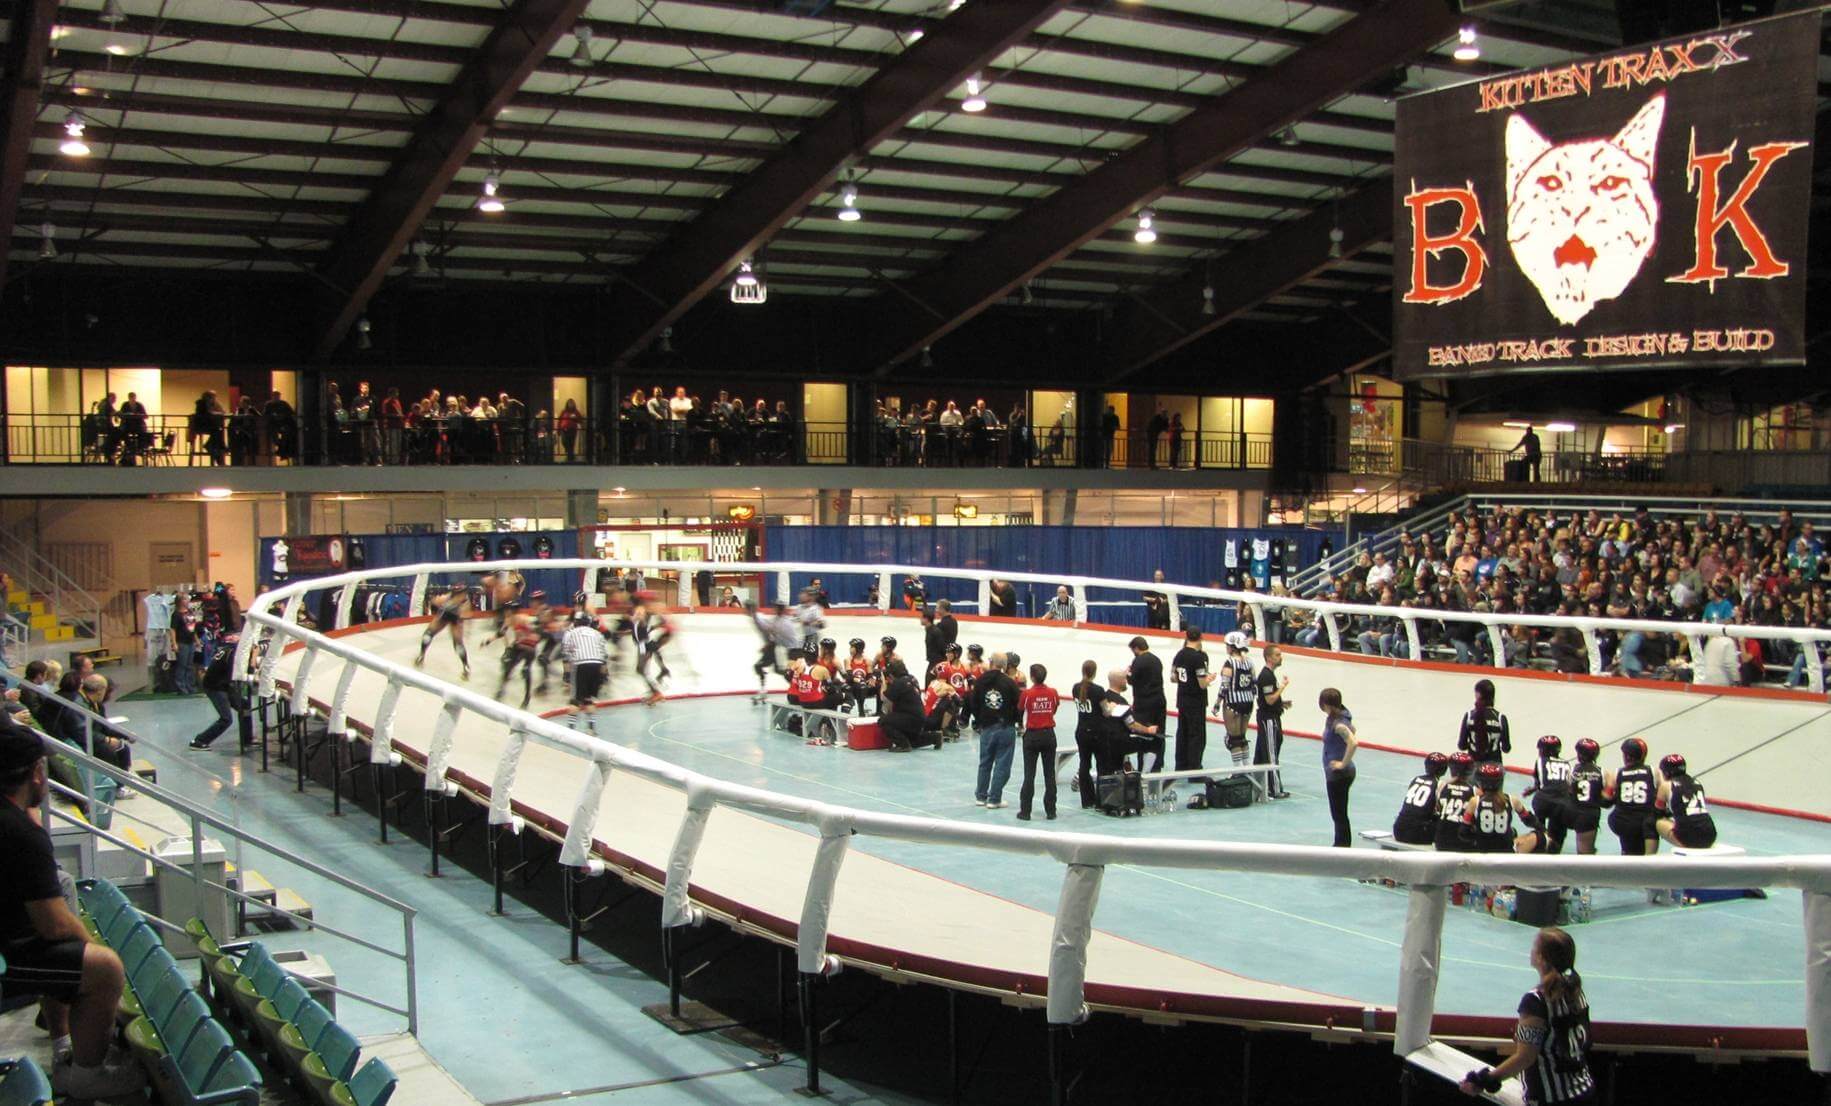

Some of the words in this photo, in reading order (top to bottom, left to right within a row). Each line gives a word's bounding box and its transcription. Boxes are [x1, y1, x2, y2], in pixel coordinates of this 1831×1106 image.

[1475, 62, 1596, 113] KITTEN
[1665, 126, 1809, 293] K
[1402, 177, 1491, 305] B
[1496, 337, 1576, 362] TRACK
[1582, 332, 1668, 358] DESIGN
[1692, 327, 1775, 352] BUILD
[1406, 783, 1431, 807] 40
[1576, 780, 1591, 801] 3
[1620, 781, 1648, 804] 86
